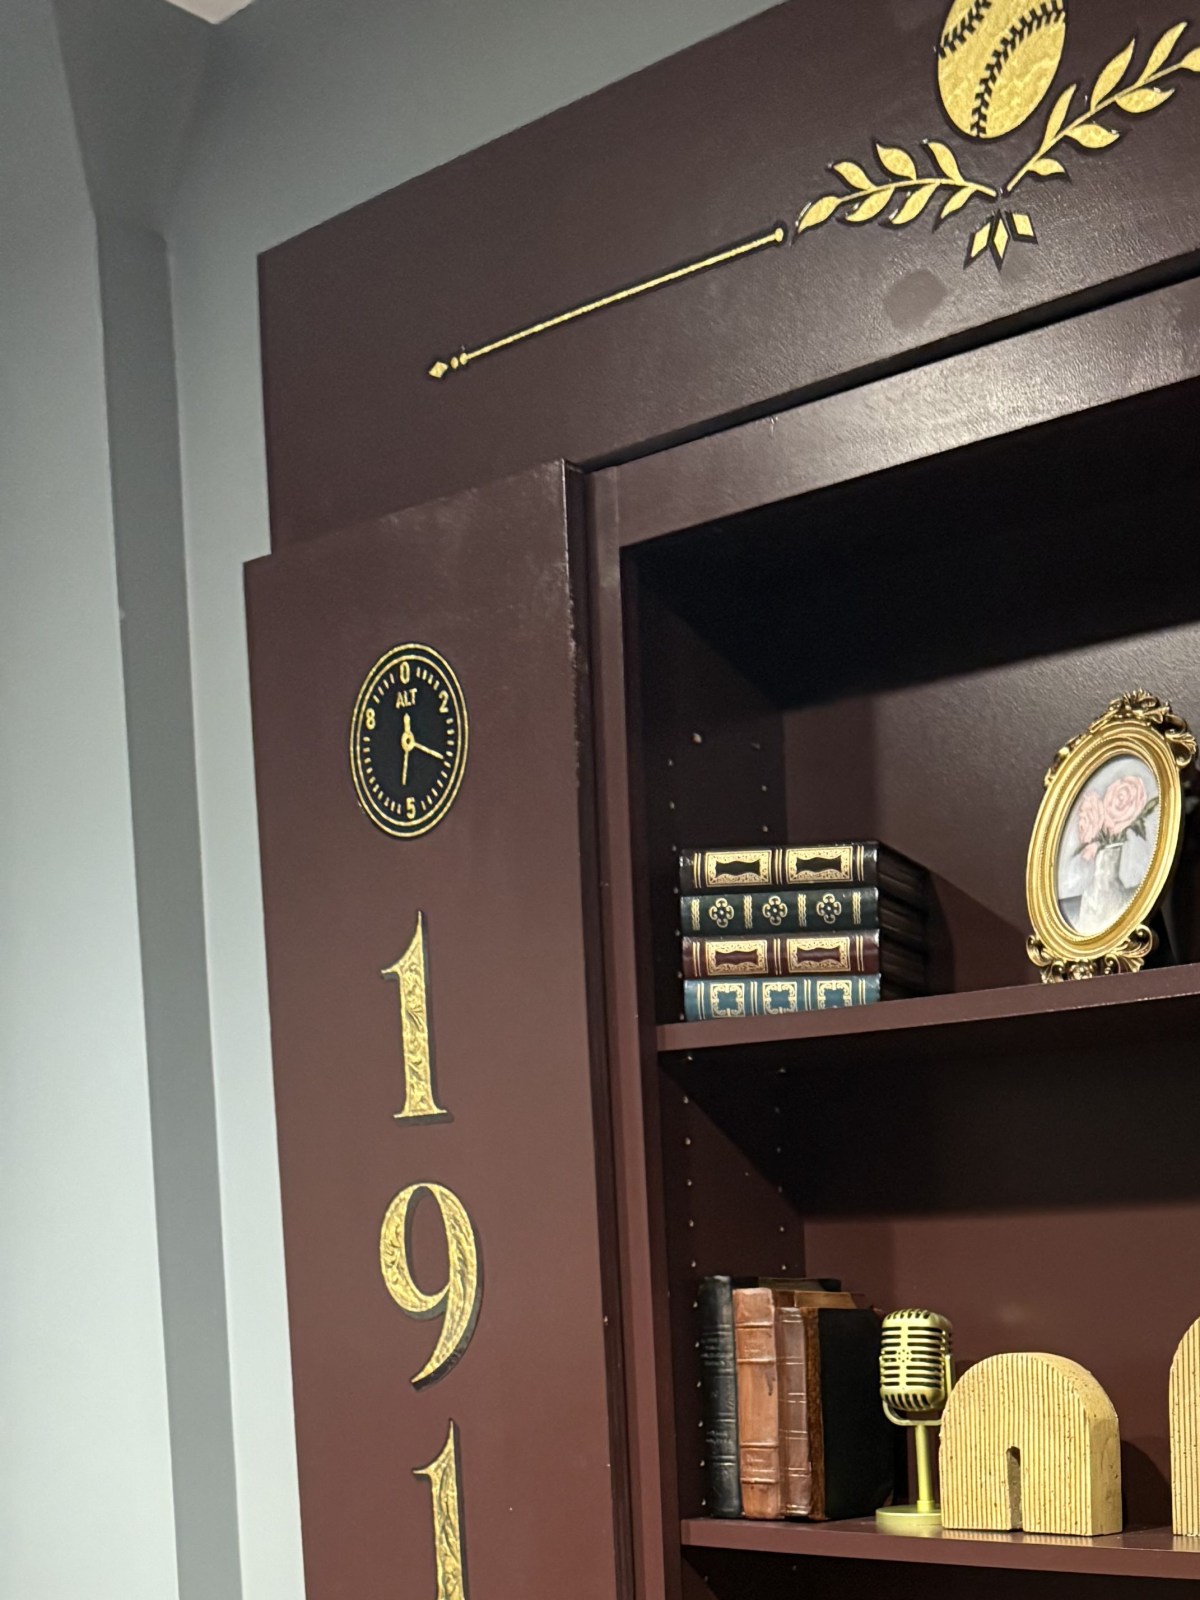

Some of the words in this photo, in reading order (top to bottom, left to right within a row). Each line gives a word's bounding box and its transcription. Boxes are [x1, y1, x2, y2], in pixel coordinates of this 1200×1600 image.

[399, 661, 411, 684] 0
[395, 688, 418, 709] ALT
[438, 691, 450, 714] 2
[365, 708, 377, 730] 8
[404, 797, 416, 819] 5
